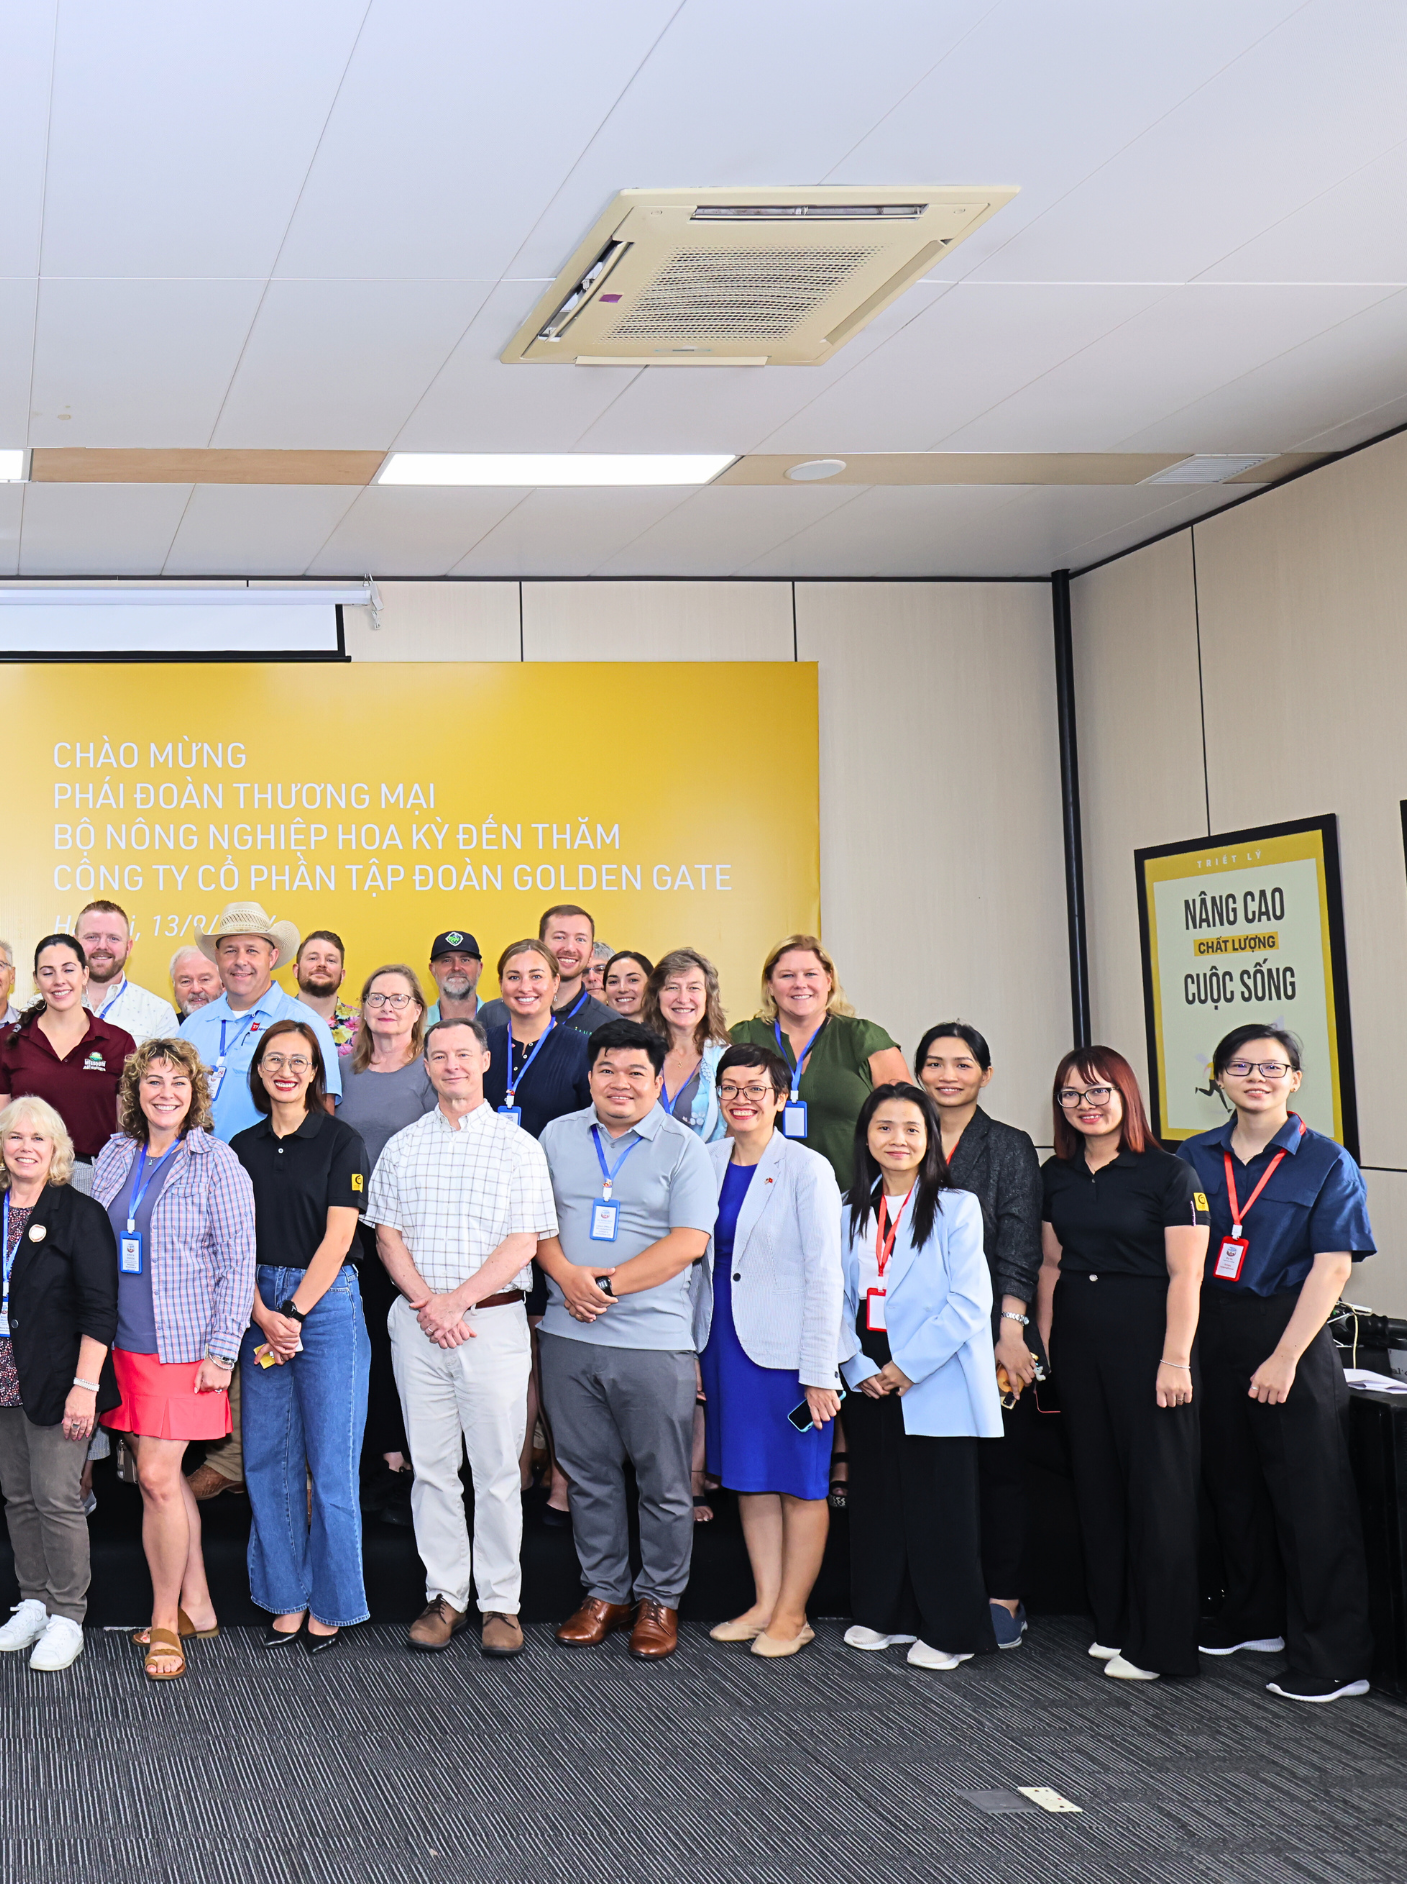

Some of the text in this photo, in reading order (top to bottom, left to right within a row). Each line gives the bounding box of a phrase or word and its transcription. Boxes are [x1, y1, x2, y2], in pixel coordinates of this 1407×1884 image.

[54, 735, 246, 768] CHÀO MỪNG
[55, 776, 434, 815] PHÁI ĐOÀN THƯƠNG MẠI
[54, 814, 619, 856] BỘ NÔNG NGHIỆP HOA KỲ ĐẾN THĂM
[54, 853, 732, 897] CÔNG TY CỔ PHẦN TẬP ĐOÀN GOLDEN GATE
[1184, 887, 1284, 930] NÂNG CAO
[1198, 935, 1276, 954] CHẤT LƯỢNG
[1184, 959, 1295, 1010] CUỘC SỐNG
